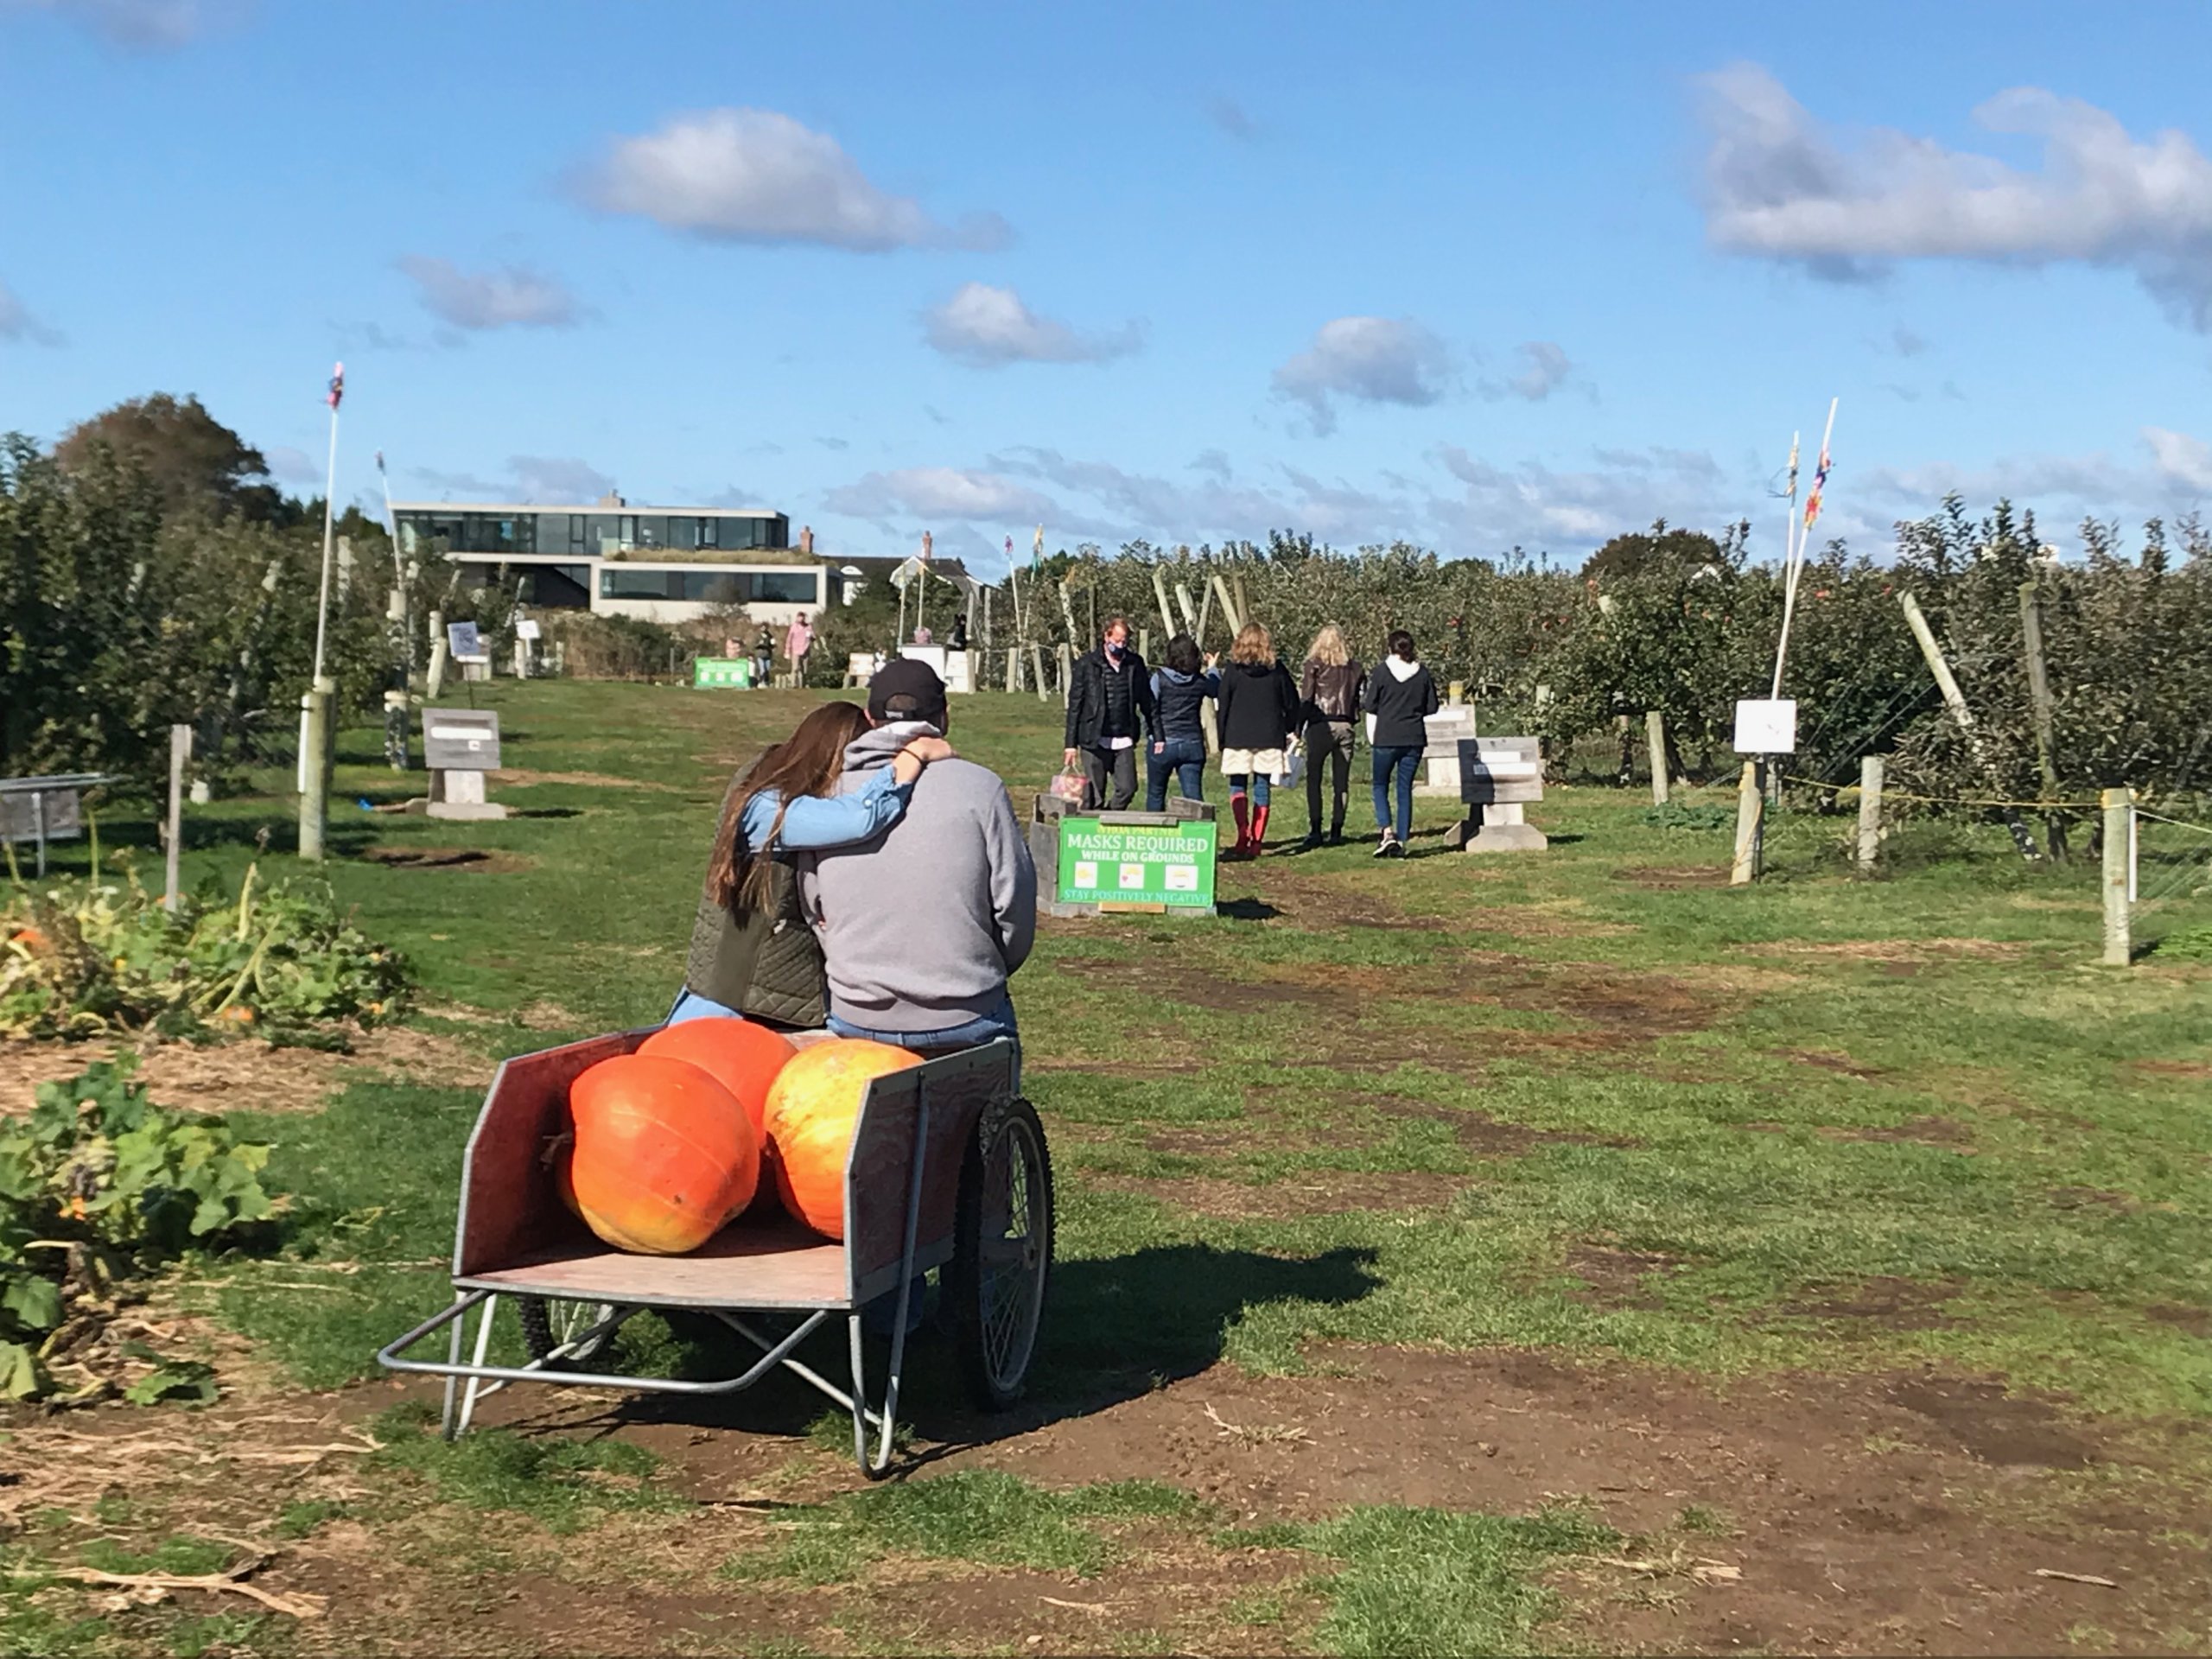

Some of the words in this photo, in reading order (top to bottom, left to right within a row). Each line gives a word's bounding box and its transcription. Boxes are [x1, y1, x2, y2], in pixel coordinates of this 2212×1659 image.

[1068, 834, 1121, 849] MASKS
[1126, 836, 1208, 853] REQUIRED
[1082, 850, 1119, 861] WHILE
[1122, 851, 1137, 862] ON
[1140, 852, 1195, 863] GROUNDS
[1065, 889, 1088, 900] STAY
[1091, 891, 1153, 902] POSITIVELY
[1155, 893, 1208, 904] NEGATIVE
